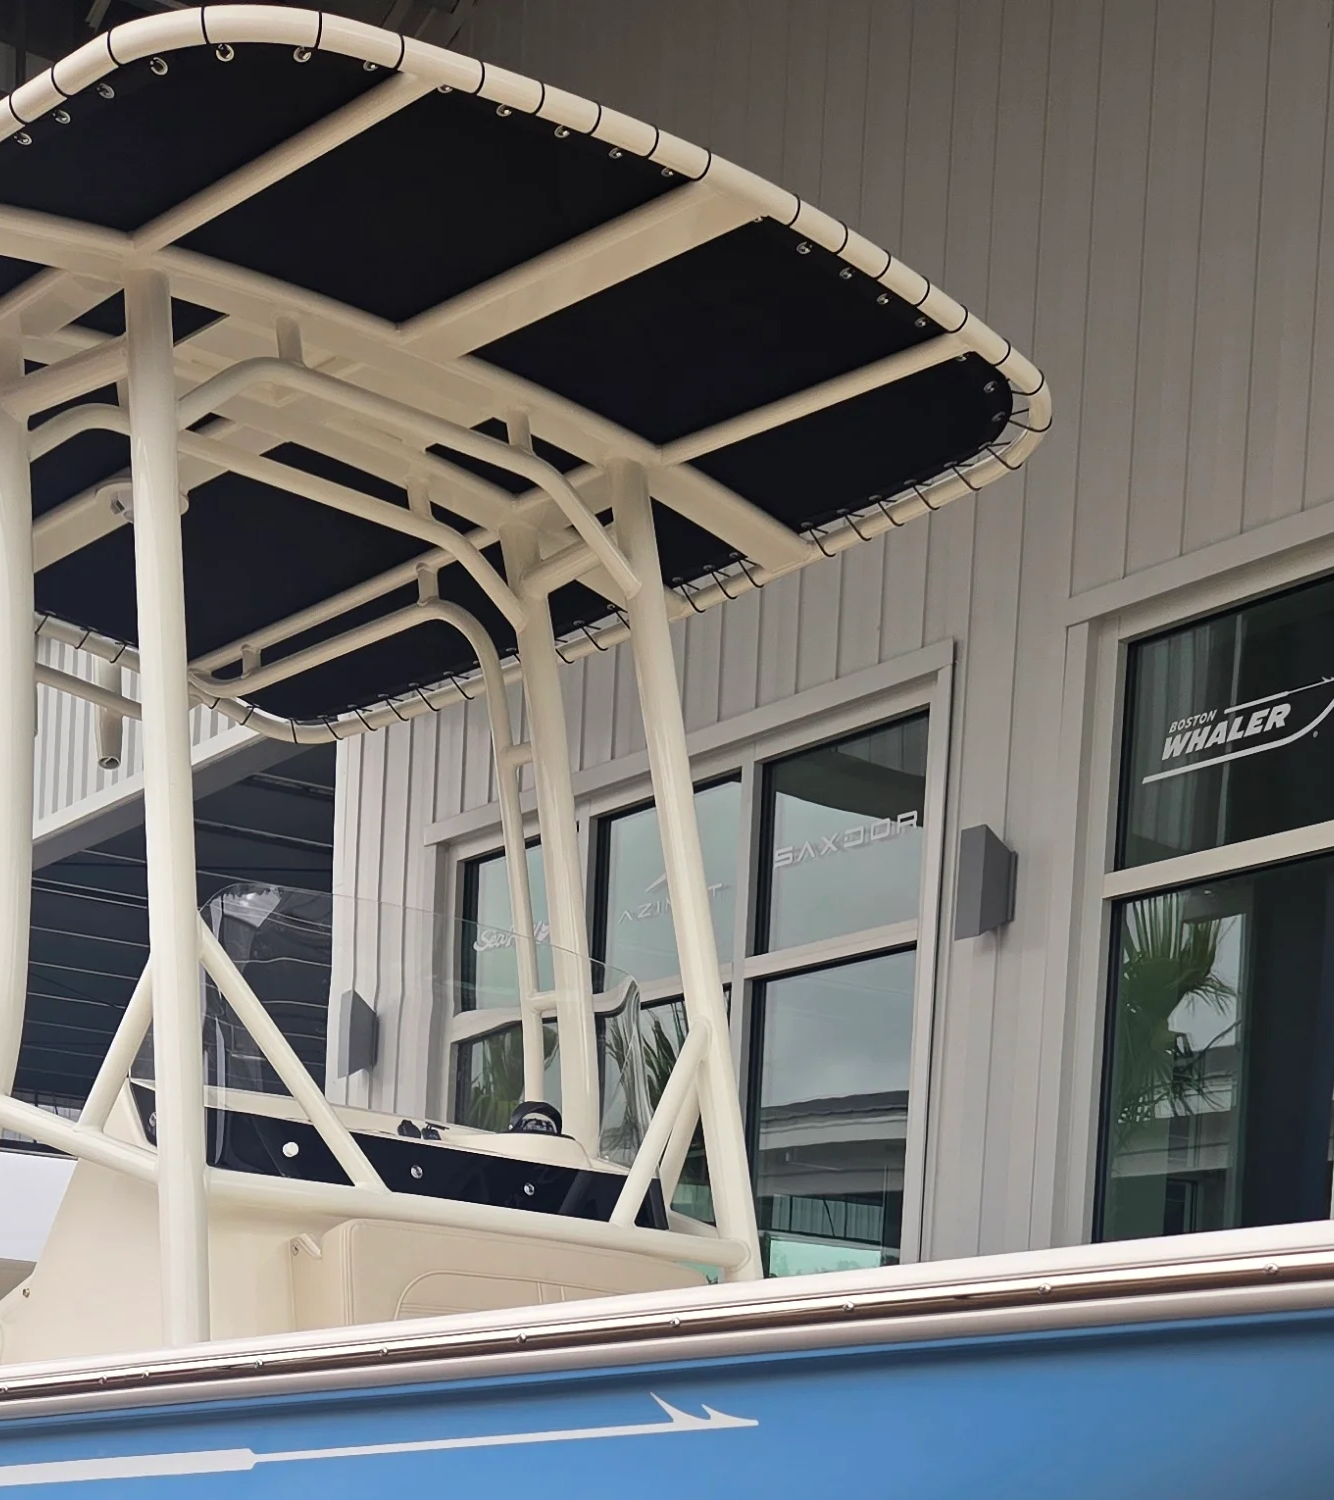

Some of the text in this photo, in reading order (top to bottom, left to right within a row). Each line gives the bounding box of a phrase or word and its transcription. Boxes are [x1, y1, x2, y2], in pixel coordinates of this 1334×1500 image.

[1161, 703, 1292, 761] WHALER
[1168, 709, 1218, 734] BOSTON
[618, 883, 723, 925] AZIT
